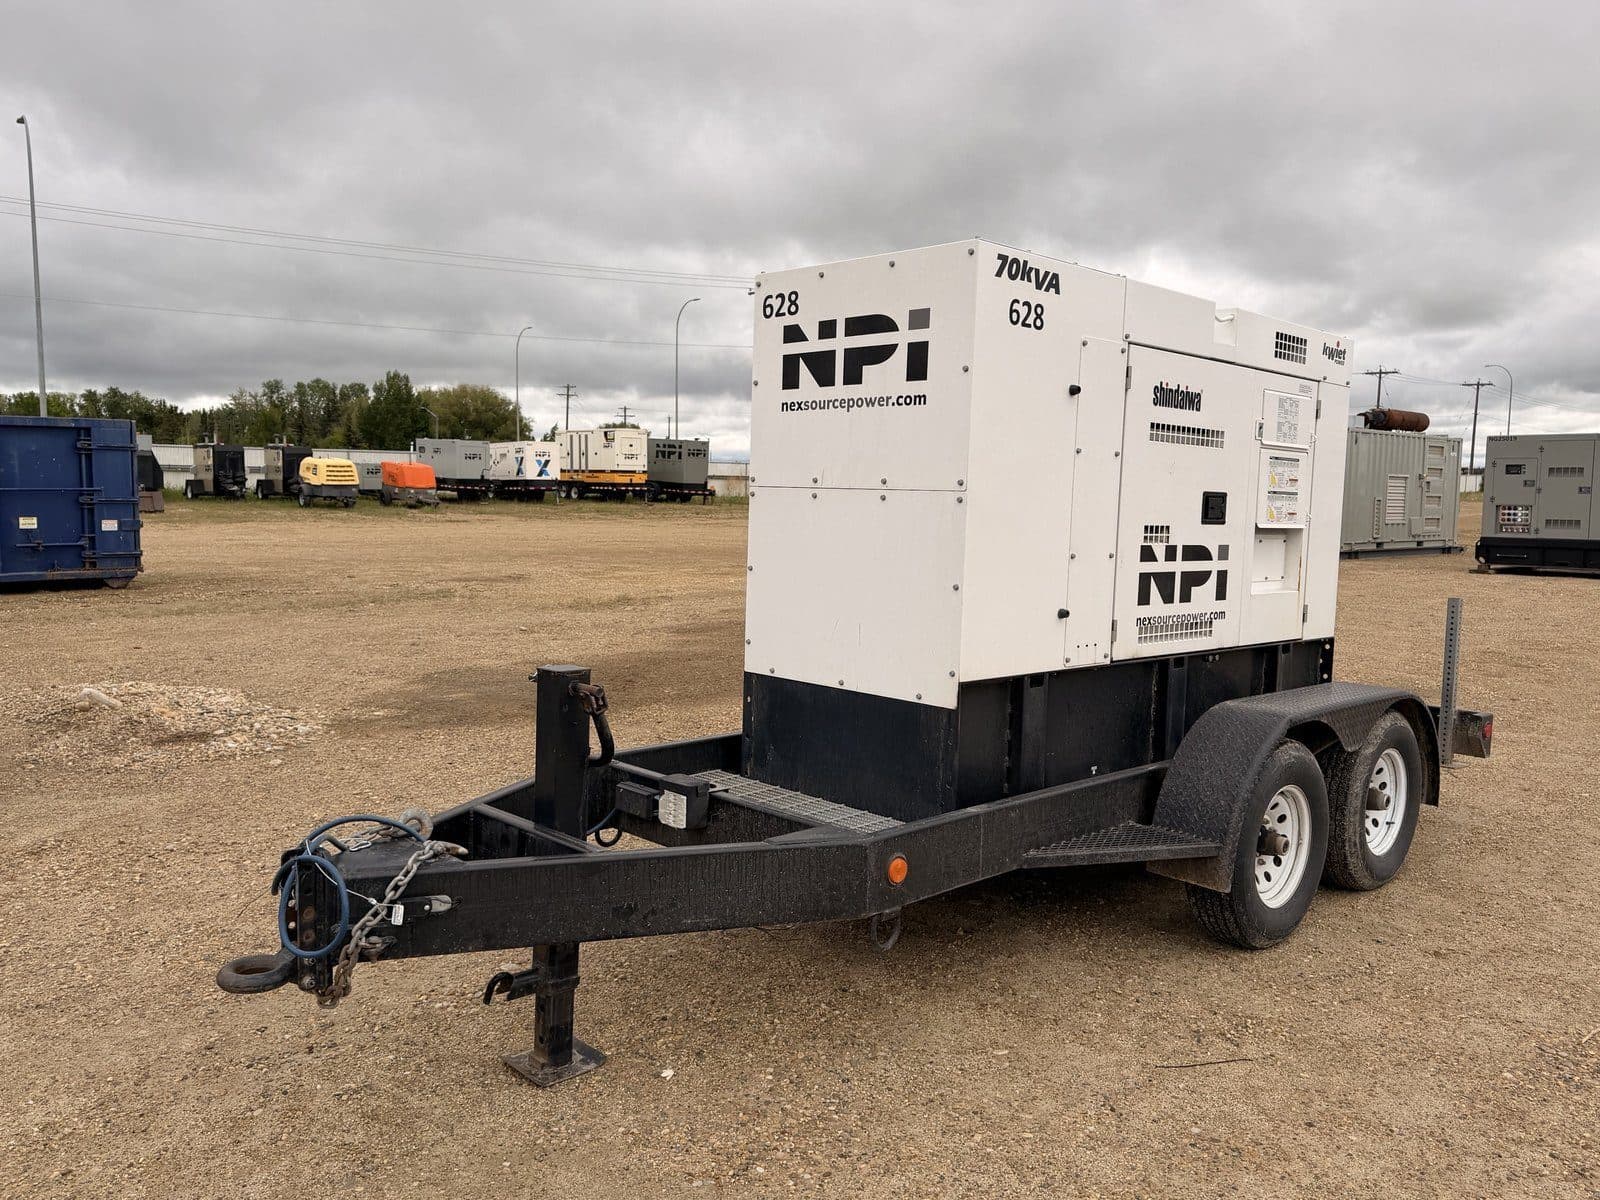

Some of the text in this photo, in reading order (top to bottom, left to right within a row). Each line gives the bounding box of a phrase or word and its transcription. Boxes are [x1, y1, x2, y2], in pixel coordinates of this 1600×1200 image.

[994, 253, 1061, 295] 70kVA
[762, 290, 800, 319] 628
[1009, 298, 1045, 331] 628
[1322, 340, 1347, 361] kwiet
[781, 393, 927, 412] nexsourcepower.com
[1152, 381, 1202, 412] shindaiwa
[1136, 609, 1226, 627] nexsourcepower.com
